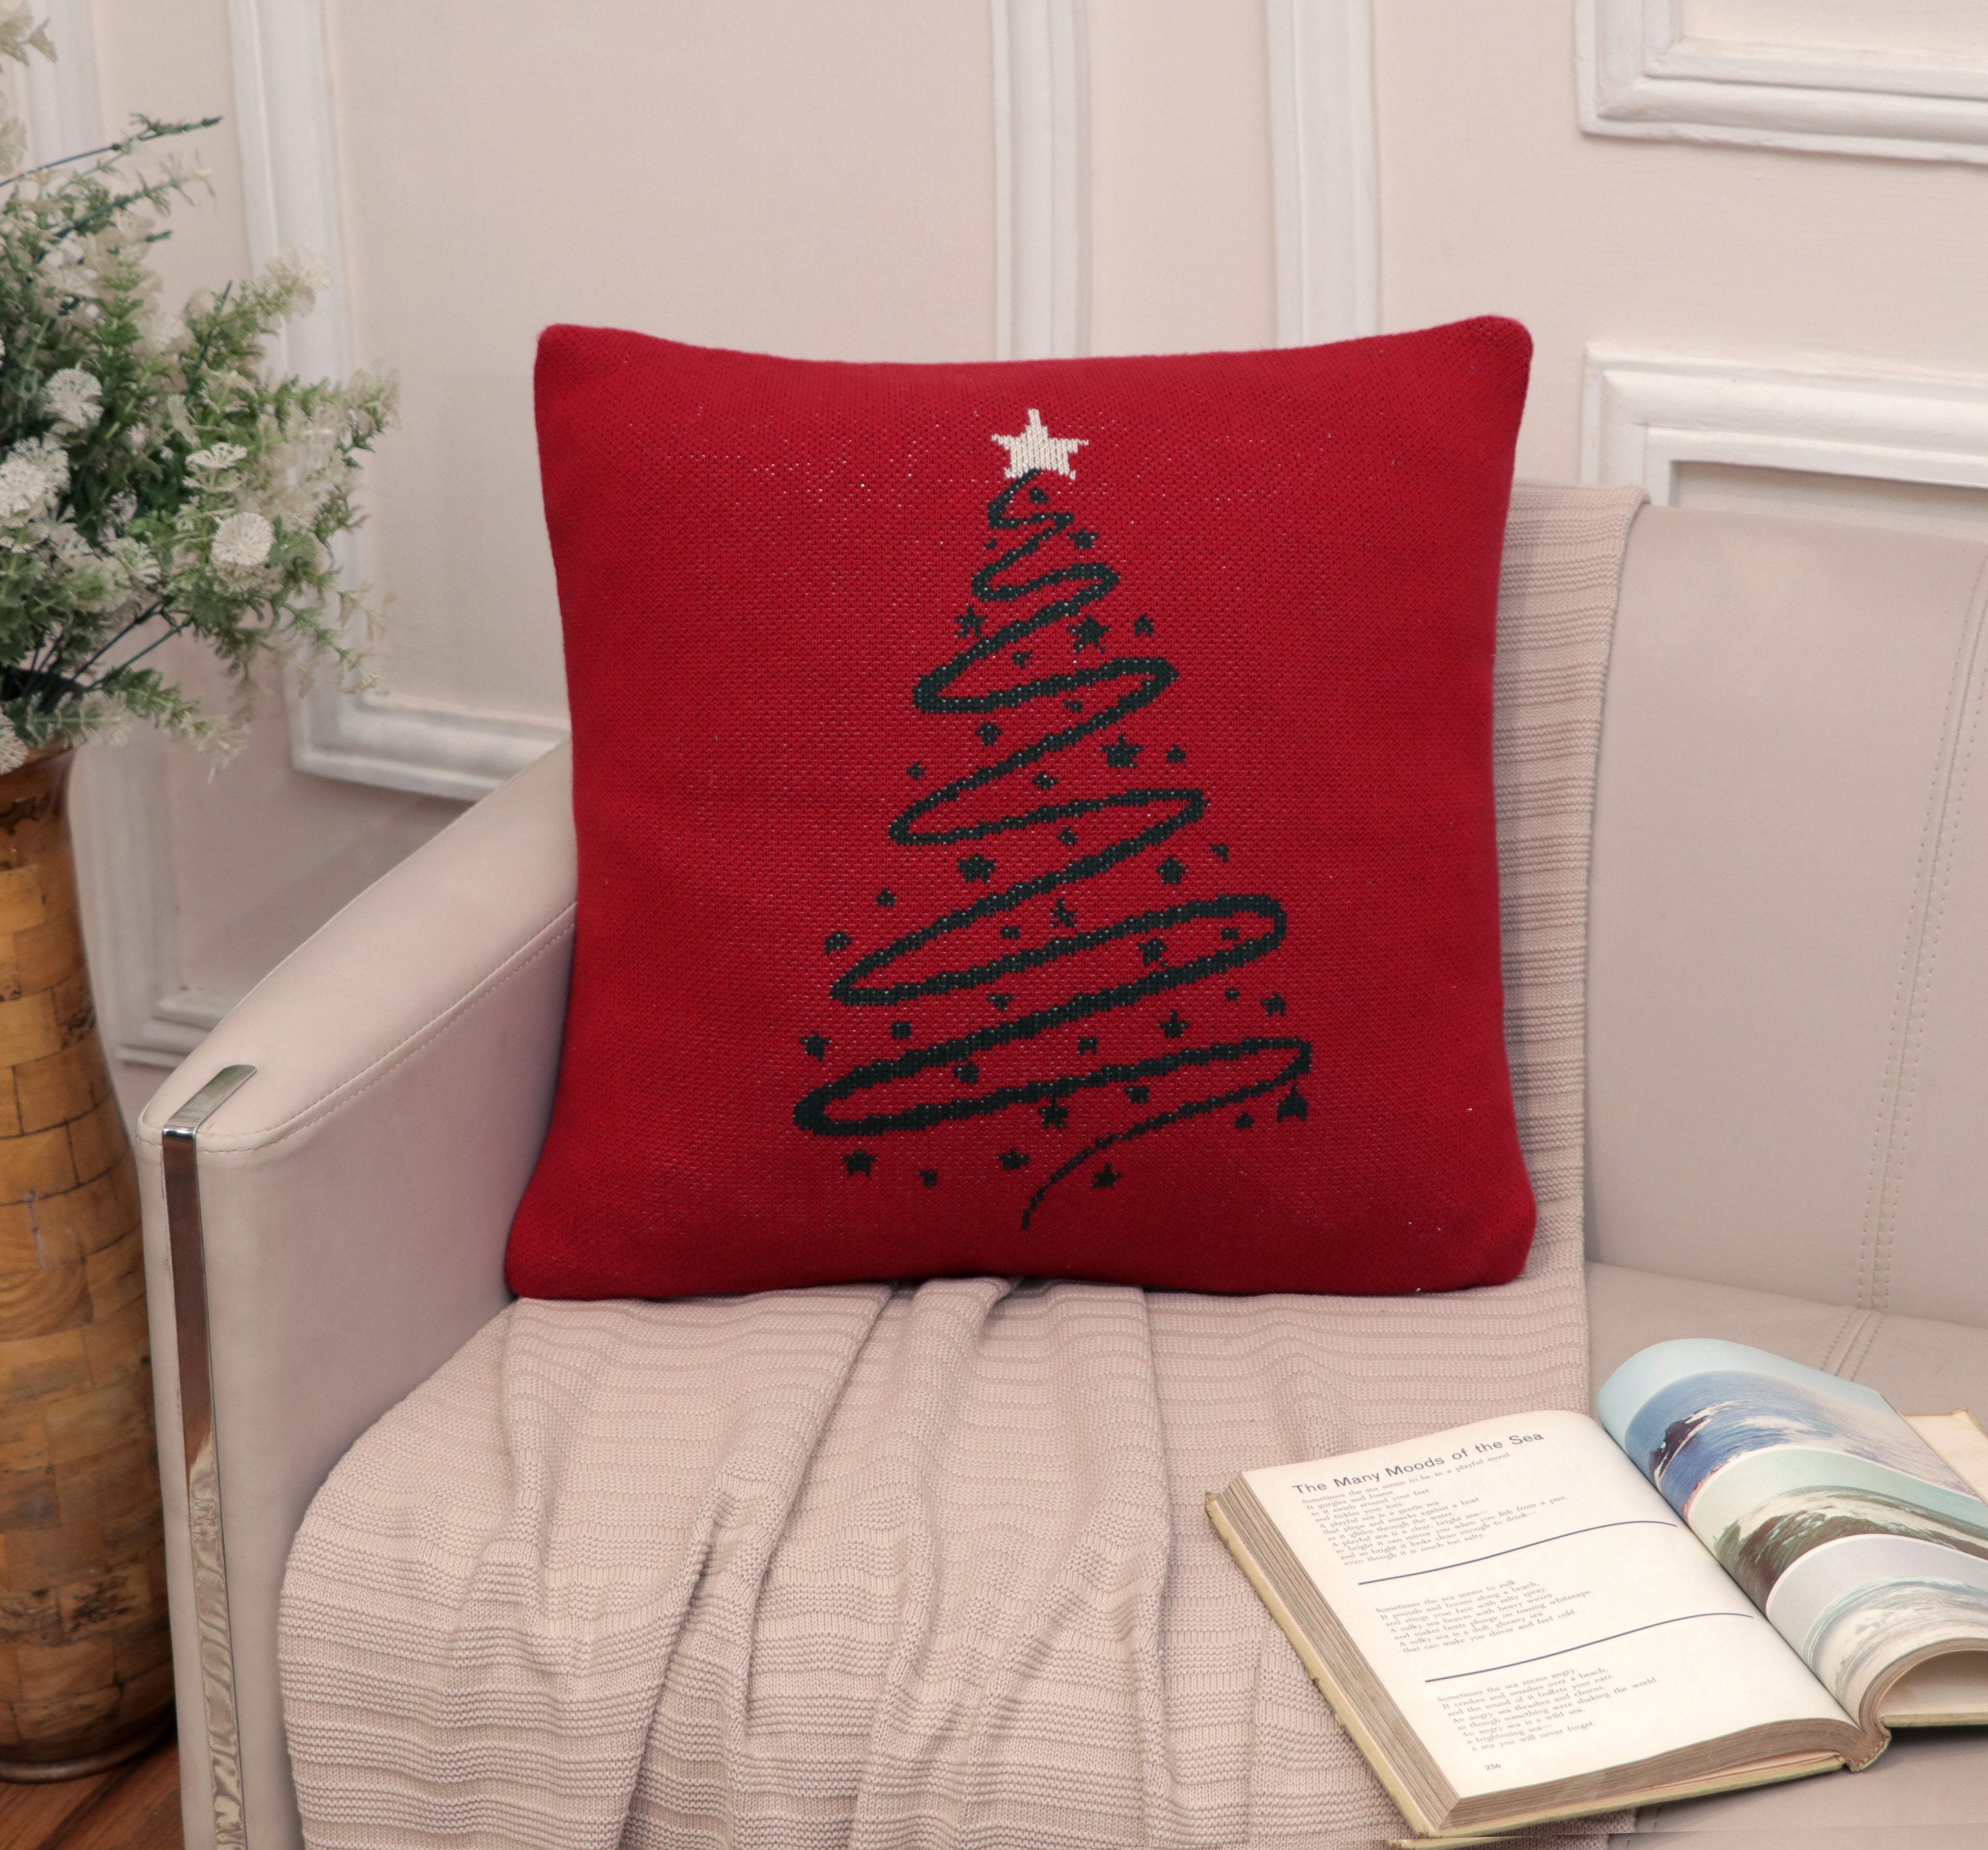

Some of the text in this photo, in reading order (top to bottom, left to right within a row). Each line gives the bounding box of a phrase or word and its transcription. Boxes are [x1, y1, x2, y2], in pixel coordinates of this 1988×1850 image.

[1292, 1433, 1544, 1494] The Many Moods of the Sea
[1302, 1493, 1346, 1504] Sometimes
[1382, 1480, 1406, 1489] seems
[1456, 1459, 1484, 1472] playful
[1318, 1499, 1347, 1509] gurgles
[1369, 1490, 1394, 1499] foams
[1360, 1497, 1388, 1507] around
[1392, 1494, 1410, 1504] your
[1330, 1518, 1358, 1528] playful
[1398, 1505, 1423, 1514] gentle
[1334, 1510, 1360, 1519] tickles
[1343, 1523, 1365, 1533] plops
[1388, 1513, 1417, 1523] smacks
[1420, 1505, 1449, 1516] against
[1461, 1497, 1480, 1506] boat
[1348, 1543, 1373, 1553] bright
[1406, 1531, 1431, 1539] mirror
[1435, 1526, 1451, 1536] you
[1454, 1520, 1477, 1529] when
[1480, 1514, 1496, 1523] you
[1516, 1503, 1537, 1511] from
[1342, 1536, 1371, 1547] playful
[1436, 1517, 1461, 1526] bright
[1350, 1529, 1373, 1538] glides
[1377, 1521, 1409, 1532] through
[1371, 1545, 1396, 1554] bright
[1410, 1537, 1432, 1546] looks
[1435, 1532, 1457, 1541] clean
[1460, 1524, 1490, 1535] enough
[1367, 1552, 1397, 1563] though
[1421, 1542, 1447, 1552] much
[1375, 1602, 1421, 1613] Sometimes
[1458, 1589, 1483, 1598] seems
[1392, 1609, 1423, 1619] pounds
[1445, 1599, 1473, 1608] booms
[1477, 1592, 1500, 1601] along
[1400, 1623, 1423, 1632] sulky
[1443, 1614, 1472, 1624] heaves
[1475, 1608, 1495, 1616] with
[1498, 1601, 1523, 1611] heavy
[1526, 1593, 1553, 1604] waves
[1405, 1615, 1429, 1623] stings
[1432, 1611, 1452, 1620] your
[1477, 1600, 1496, 1609] with
[1500, 1595, 1519, 1604] salty
[1410, 1636, 1431, 1645] sulky
[1496, 1616, 1526, 1628] gloomy
[1414, 1628, 1440, 1637] makes
[1443, 1623, 1467, 1631] boats
[1470, 1615, 1499, 1627] plunge
[1516, 1603, 1546, 1615] tossing
[1443, 1638, 1466, 1647] make
[1469, 1634, 1485, 1642] you
[1489, 1628, 1514, 1637] shiver
[1518, 1621, 1534, 1630] and
[1537, 1616, 1554, 1625] feel
[1437, 1691, 1483, 1702] Sometimes
[1522, 1676, 1547, 1685] seems
[1454, 1697, 1485, 1707] crashes
[1510, 1685, 1544, 1696] smashes
[1485, 1699, 1511, 1709] sound
[1537, 1687, 1568, 1697] buffets
[1571, 1681, 1590, 1691] your
[1469, 1712, 1493, 1722] angry
[1514, 1699, 1551, 1711] thrashes
[1470, 1719, 1501, 1729] though
[1504, 1709, 1550, 1721] something
[1552, 1702, 1573, 1710] were
[1577, 1692, 1611, 1705] shaking
[1479, 1726, 1503, 1735] angry
[1545, 1712, 1565, 1721] wild
[1475, 1730, 1526, 1743] frightening
[1540, 1729, 1563, 1739] never
